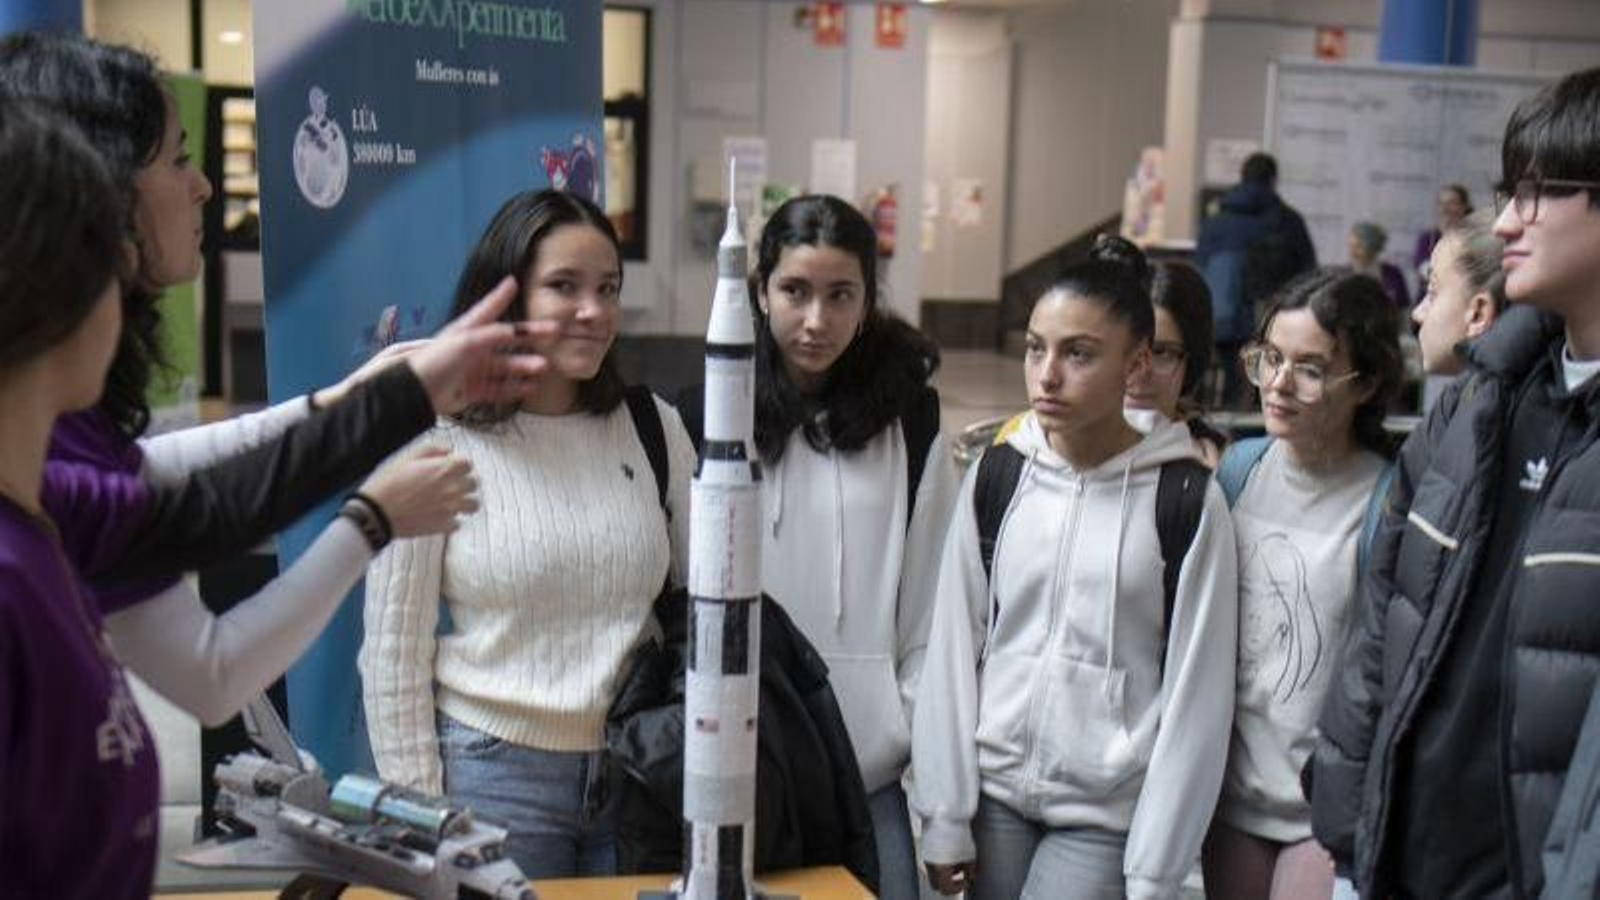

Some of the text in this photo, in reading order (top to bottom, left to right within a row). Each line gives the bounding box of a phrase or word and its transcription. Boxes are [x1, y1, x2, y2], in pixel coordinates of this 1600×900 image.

[415, 58, 465, 83] Mulleres
[466, 68, 487, 85] con
[351, 103, 378, 132] LÚA
[396, 143, 417, 164] km
